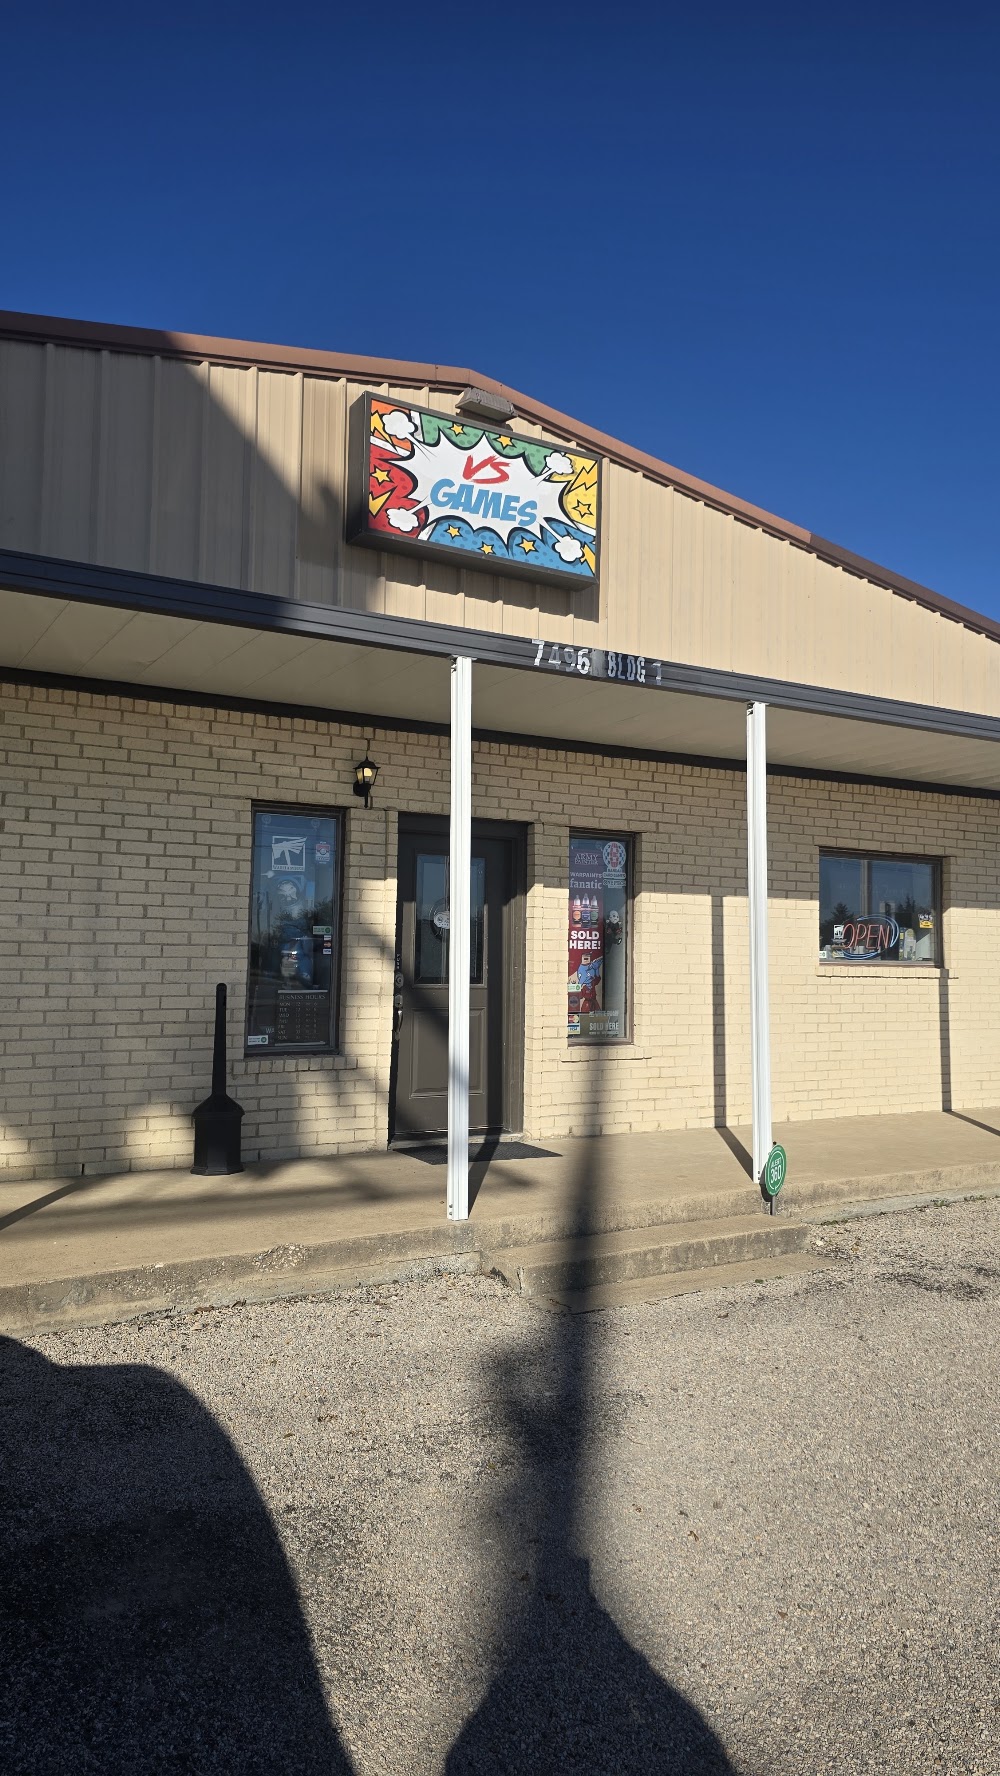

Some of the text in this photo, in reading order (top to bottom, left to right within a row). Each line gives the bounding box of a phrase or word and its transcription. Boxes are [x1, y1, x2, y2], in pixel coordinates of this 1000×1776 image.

[463, 454, 511, 484] VS
[430, 478, 538, 527] GAMES
[531, 639, 591, 675] 7496
[607, 651, 646, 683] BLDG
[575, 853, 599, 861] ARMY
[570, 878, 603, 889] fanatic
[570, 930, 600, 940] SOLD
[842, 923, 890, 949] OPEN
[569, 940, 601, 950] HERE!
[589, 1022, 604, 1030] SOLD
